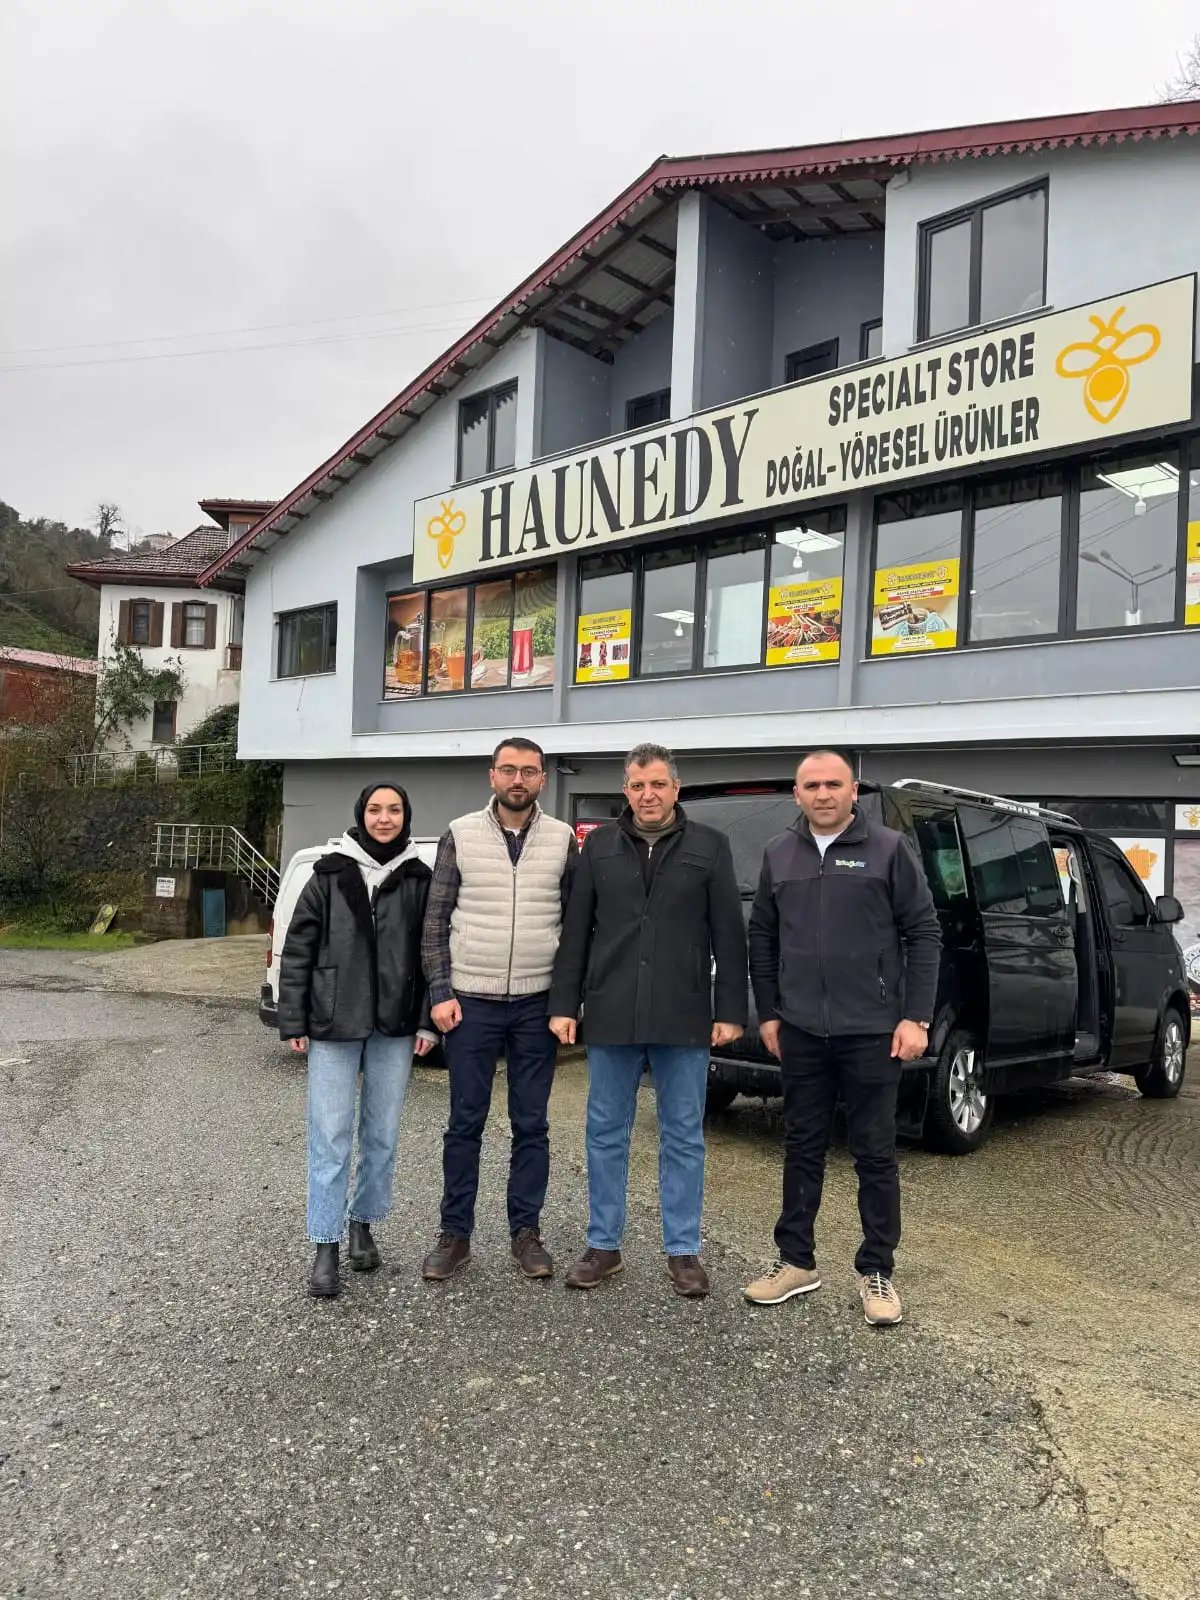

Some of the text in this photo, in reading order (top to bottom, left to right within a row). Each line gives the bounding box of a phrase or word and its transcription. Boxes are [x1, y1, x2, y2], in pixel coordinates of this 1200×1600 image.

[828, 331, 1035, 427] SPECIALT STORE
[934, 396, 1040, 462] ÜRÜNLER
[478, 408, 760, 562] HAUNEDY
